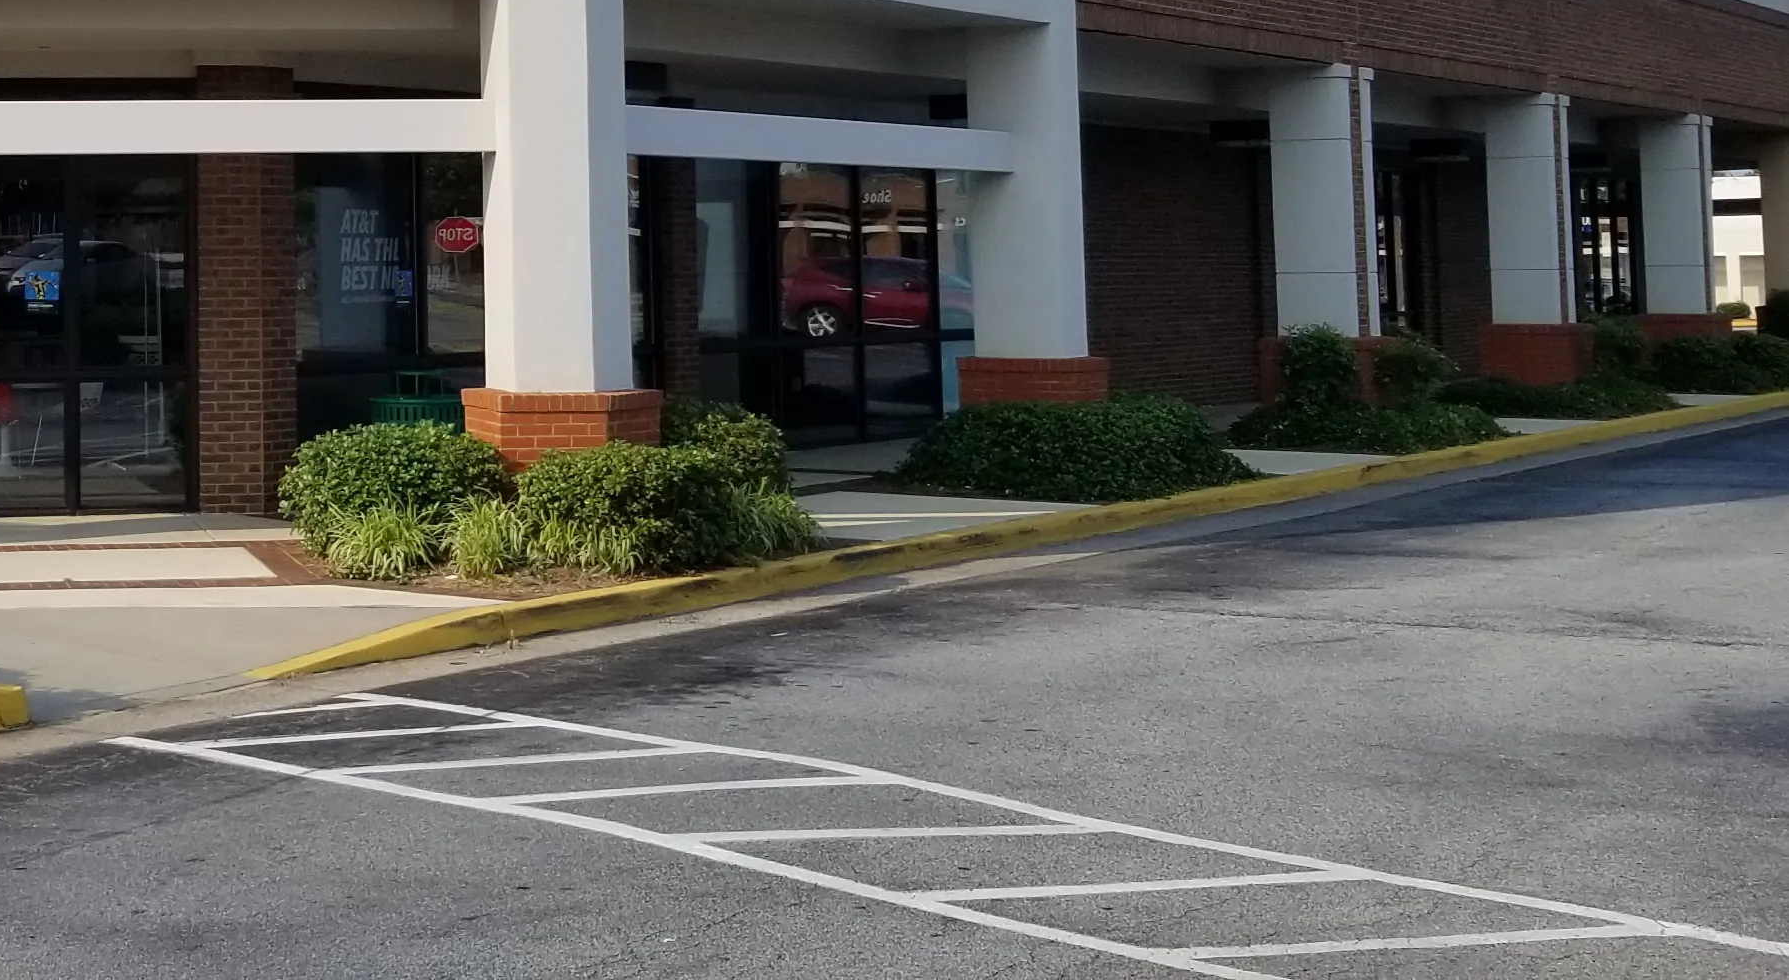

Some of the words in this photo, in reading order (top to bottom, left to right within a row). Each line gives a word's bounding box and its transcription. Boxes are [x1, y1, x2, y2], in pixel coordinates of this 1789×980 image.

[341, 210, 379, 234] AT&T
[340, 238, 371, 262] HAS
[341, 266, 378, 290] BEST
